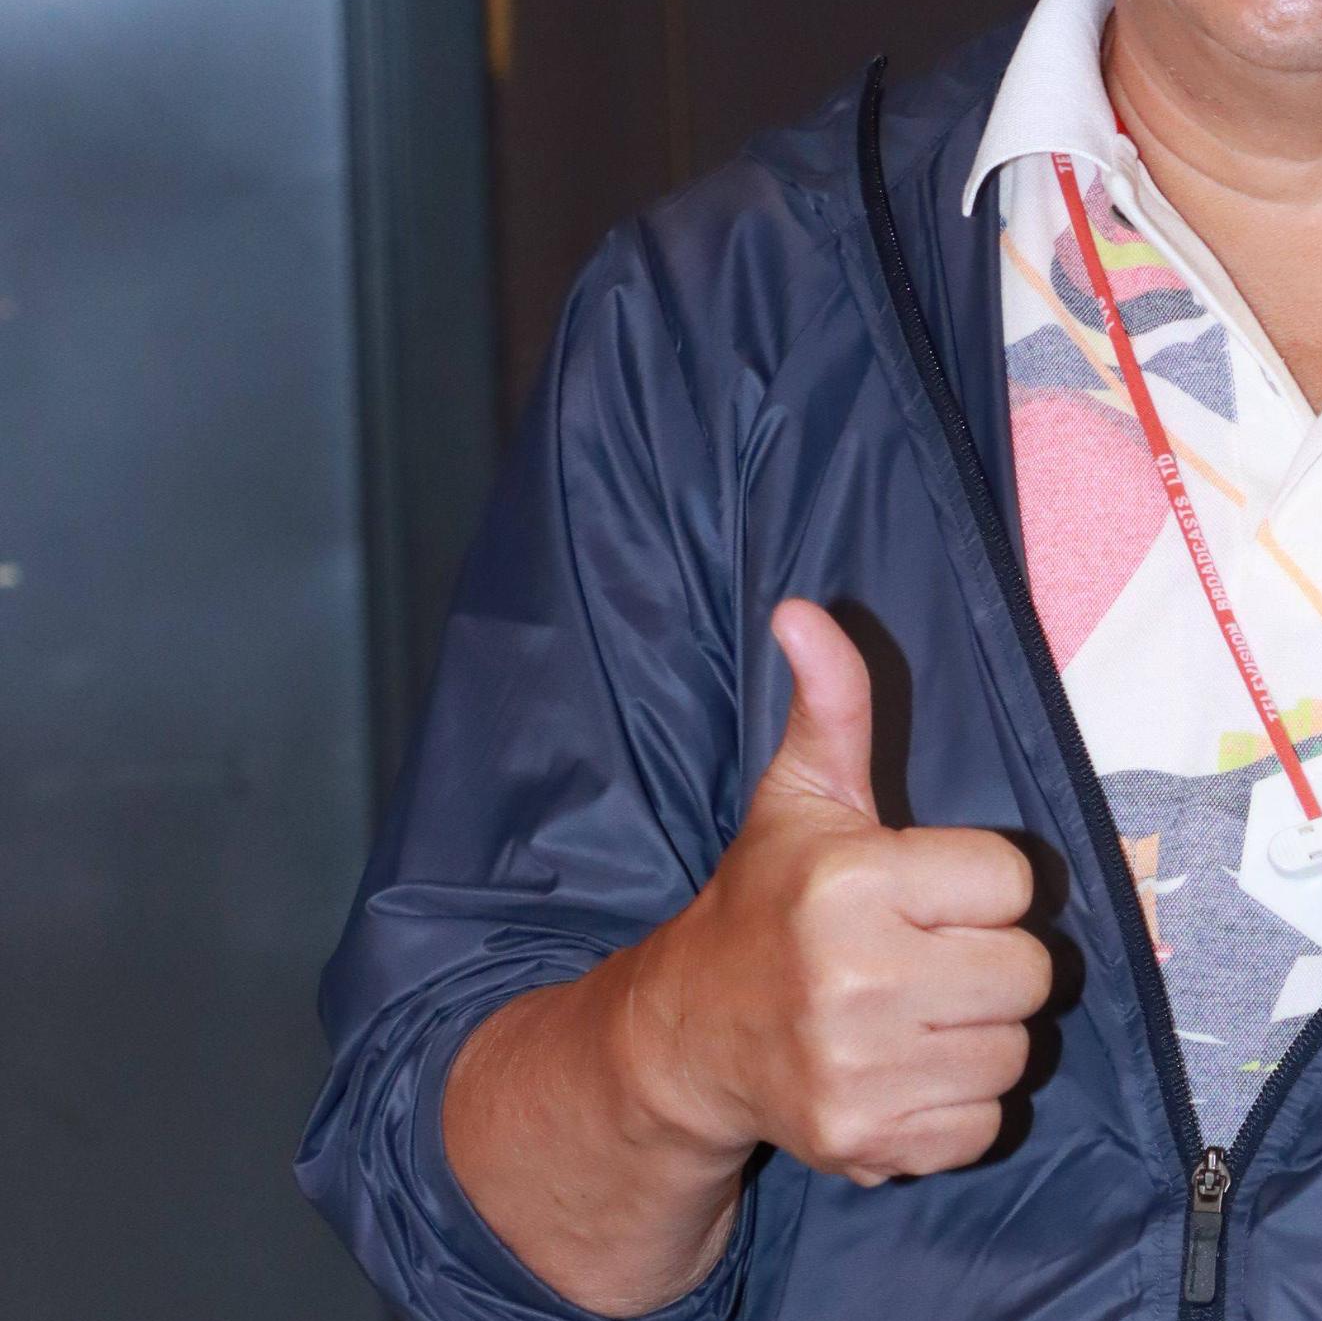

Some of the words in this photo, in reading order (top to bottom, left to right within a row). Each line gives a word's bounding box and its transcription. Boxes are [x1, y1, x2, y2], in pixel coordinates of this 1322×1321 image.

[1157, 453, 1184, 487] LTD
[1174, 495, 1233, 612] BROADCASTS
[1225, 621, 1280, 723] TELEVISION
